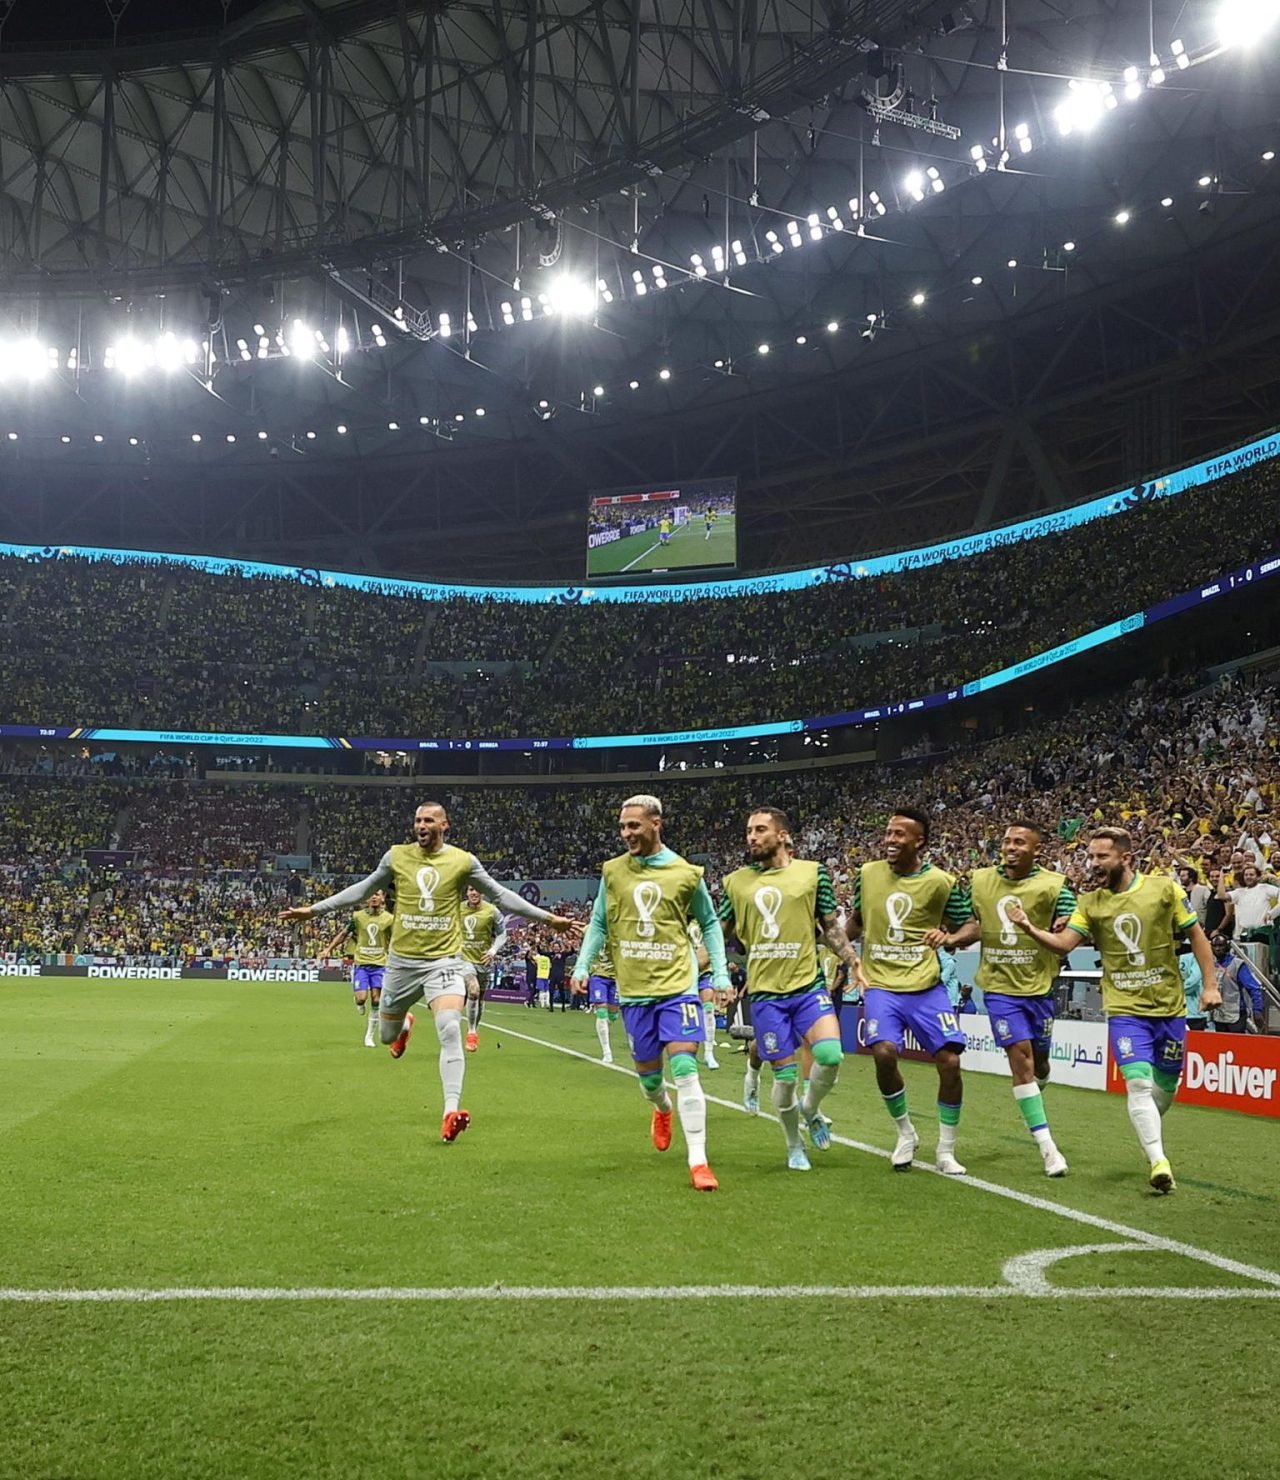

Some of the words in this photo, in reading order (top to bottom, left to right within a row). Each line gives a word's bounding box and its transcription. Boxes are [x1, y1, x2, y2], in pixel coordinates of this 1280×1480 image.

[1206, 460, 1232, 476] FIFA
[1233, 441, 1277, 465] WORLD
[588, 529, 620, 548] OWERADE
[897, 554, 921, 568] FIFA
[922, 545, 960, 562] WORLD
[962, 538, 983, 552] CUP
[420, 586, 438, 597] CUP
[623, 590, 645, 600] FIFA
[646, 588, 682, 600] WORLD
[159, 733, 175, 741] FIFA
[88, 966, 182, 979] POWERADE
[227, 969, 319, 982] POWERADE
[680, 1003, 699, 1027] 19
[937, 1012, 960, 1032] 14
[1072, 1044, 1103, 1068] قطر
